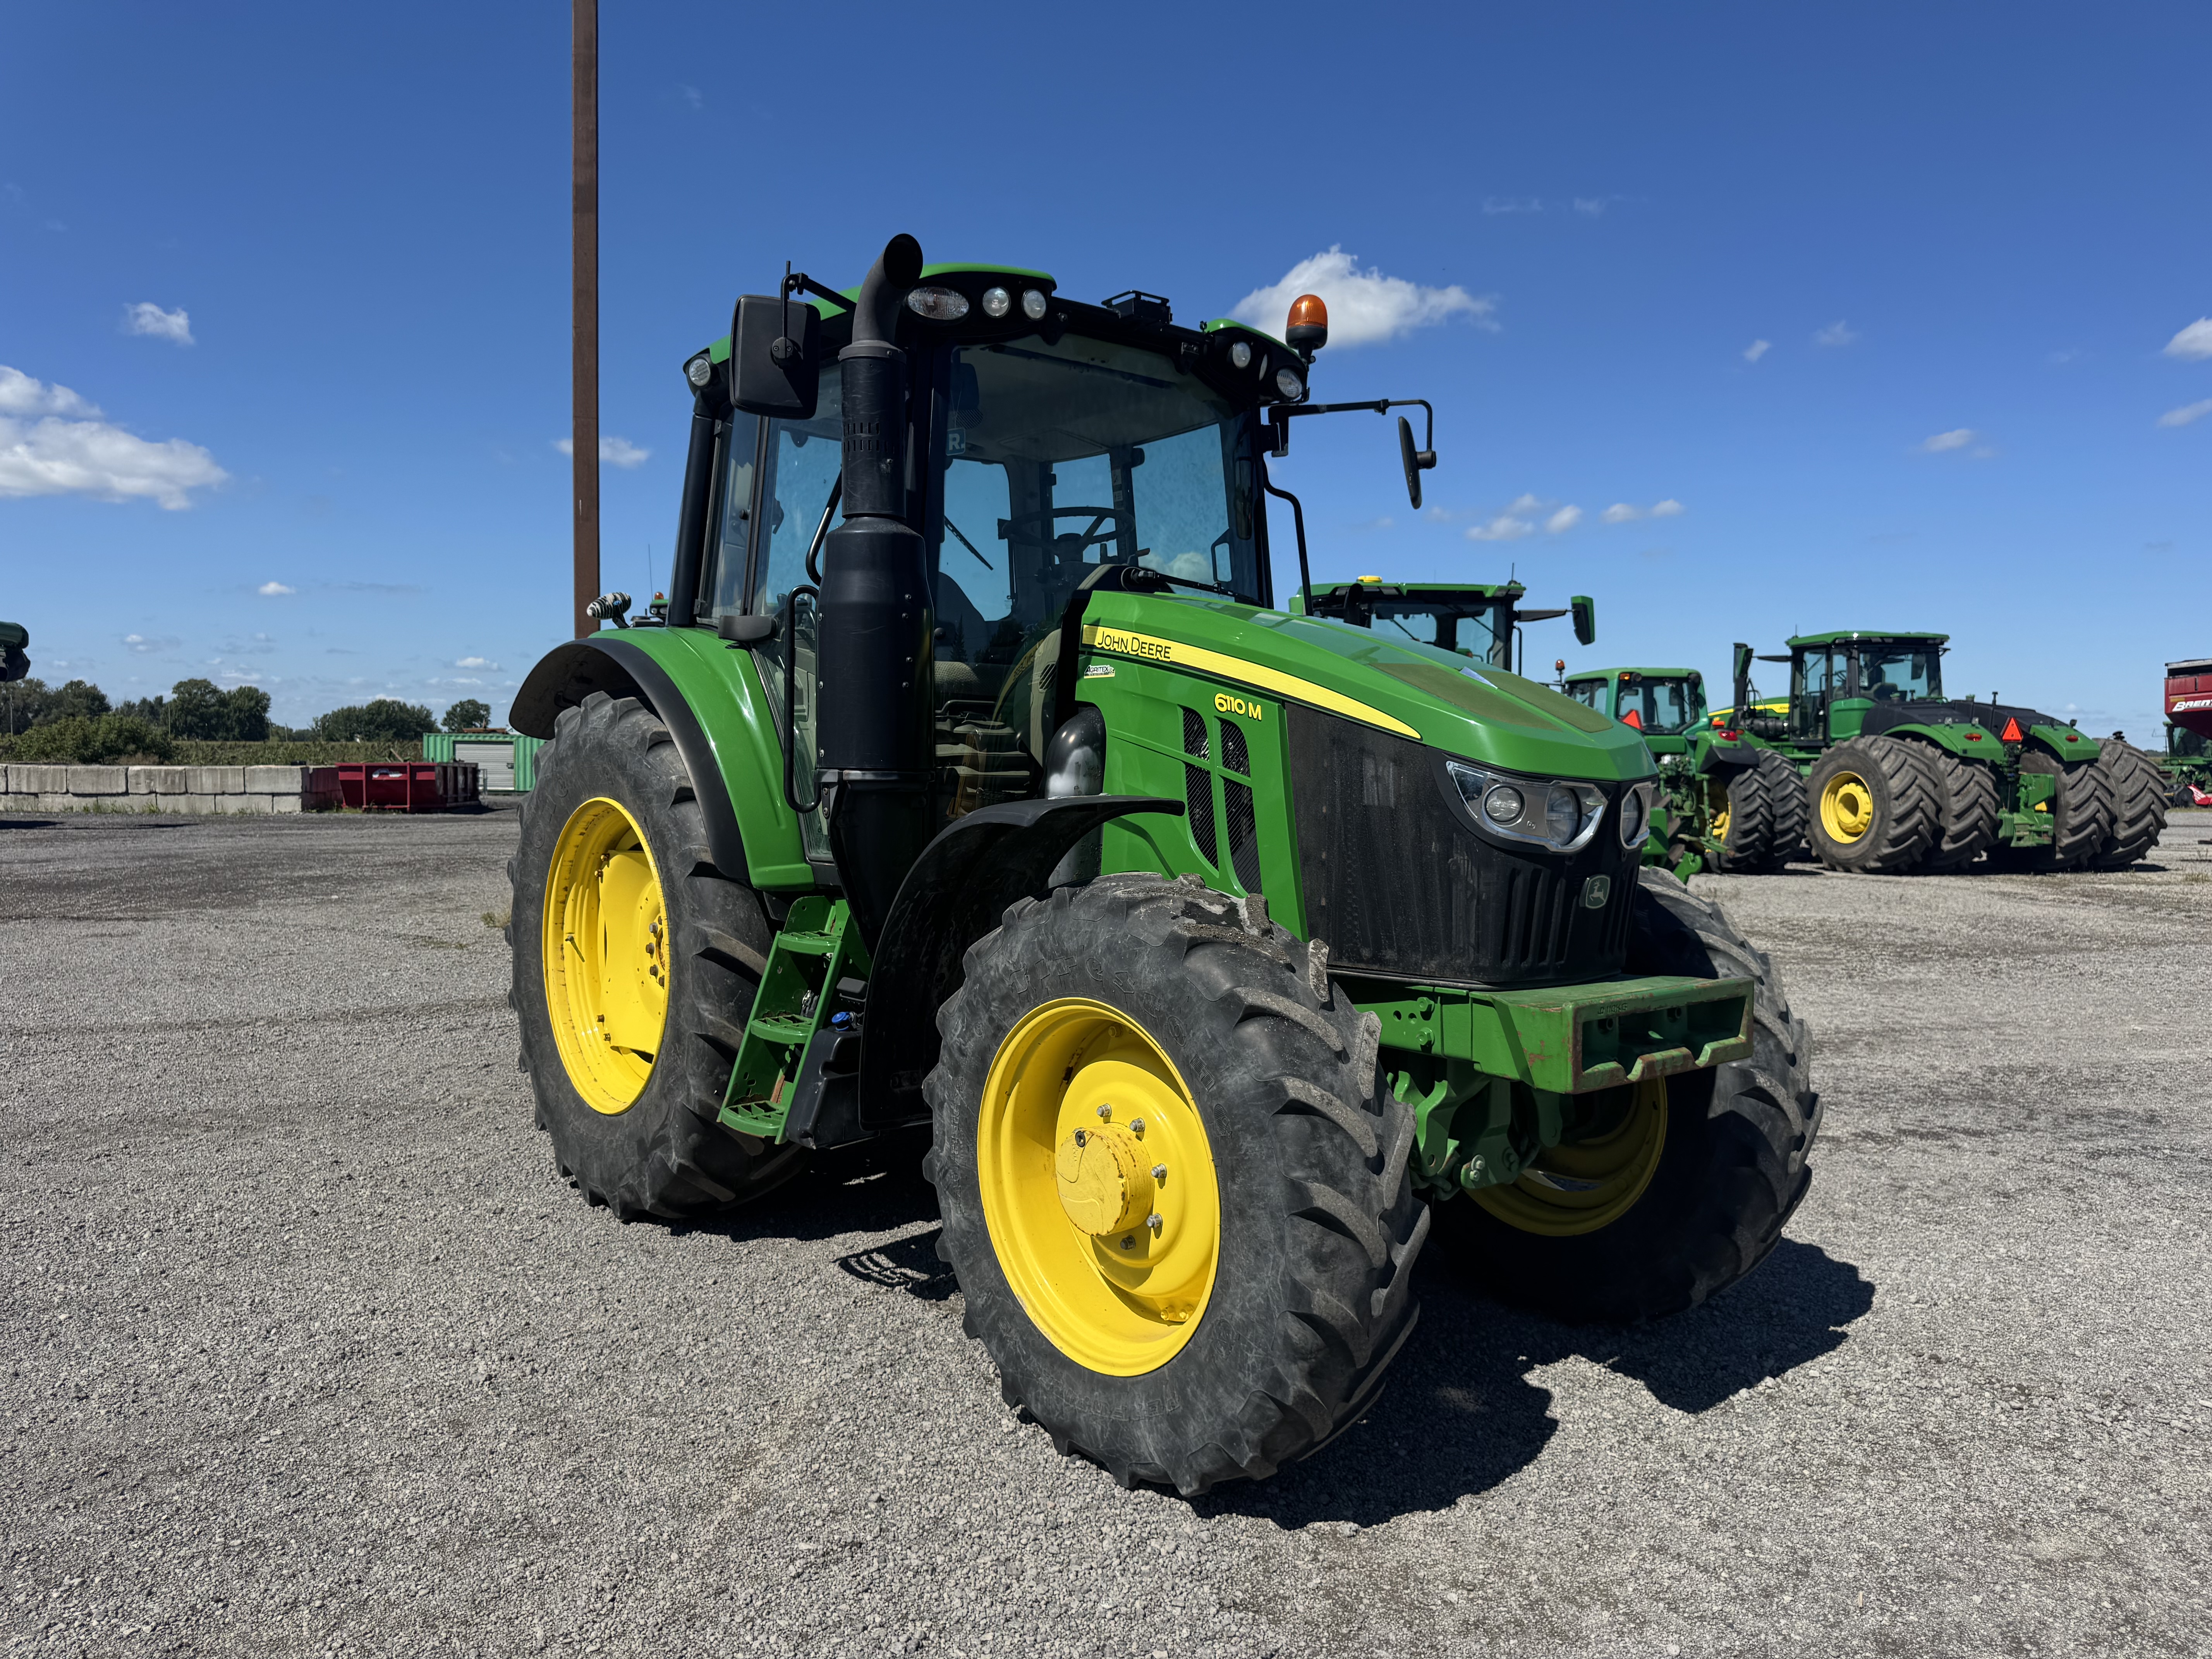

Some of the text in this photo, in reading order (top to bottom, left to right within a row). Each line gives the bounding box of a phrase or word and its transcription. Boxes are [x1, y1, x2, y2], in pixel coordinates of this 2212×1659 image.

[1097, 631, 1171, 659] JOHN DEERE
[1214, 693, 1246, 714] 6110
[2172, 699, 2212, 712] BREN
